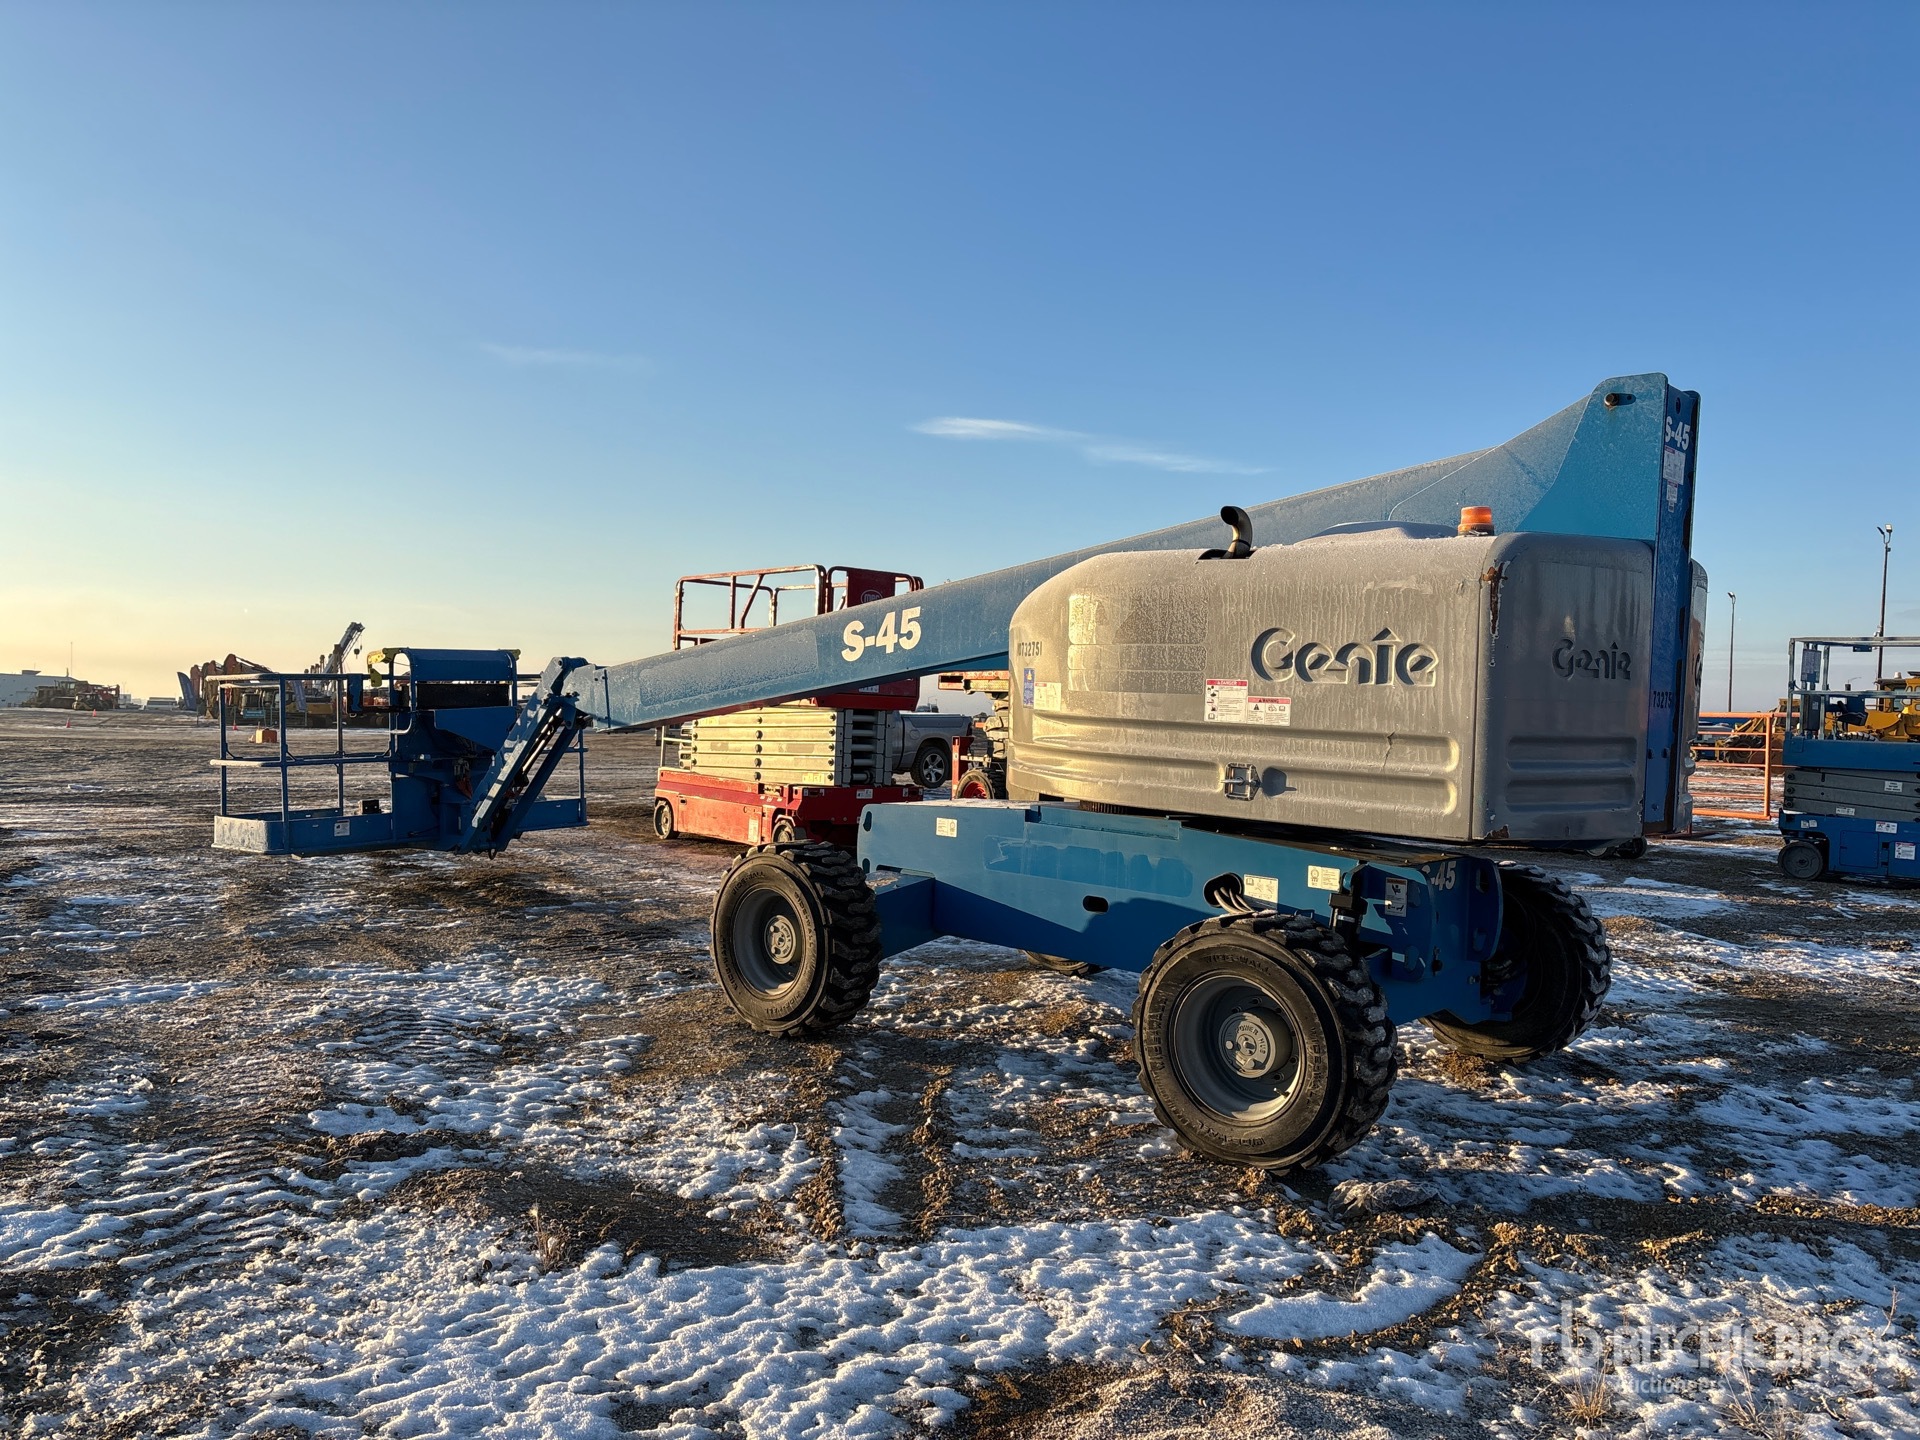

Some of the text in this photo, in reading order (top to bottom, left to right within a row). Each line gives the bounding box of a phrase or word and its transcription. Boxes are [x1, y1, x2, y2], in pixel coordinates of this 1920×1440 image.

[1665, 416, 1690, 450] S-45
[841, 606, 921, 661] S-45
[1251, 627, 1439, 687] Genie
[1552, 638, 1631, 680] Genie
[1235, 1024, 1259, 1036] POWER
